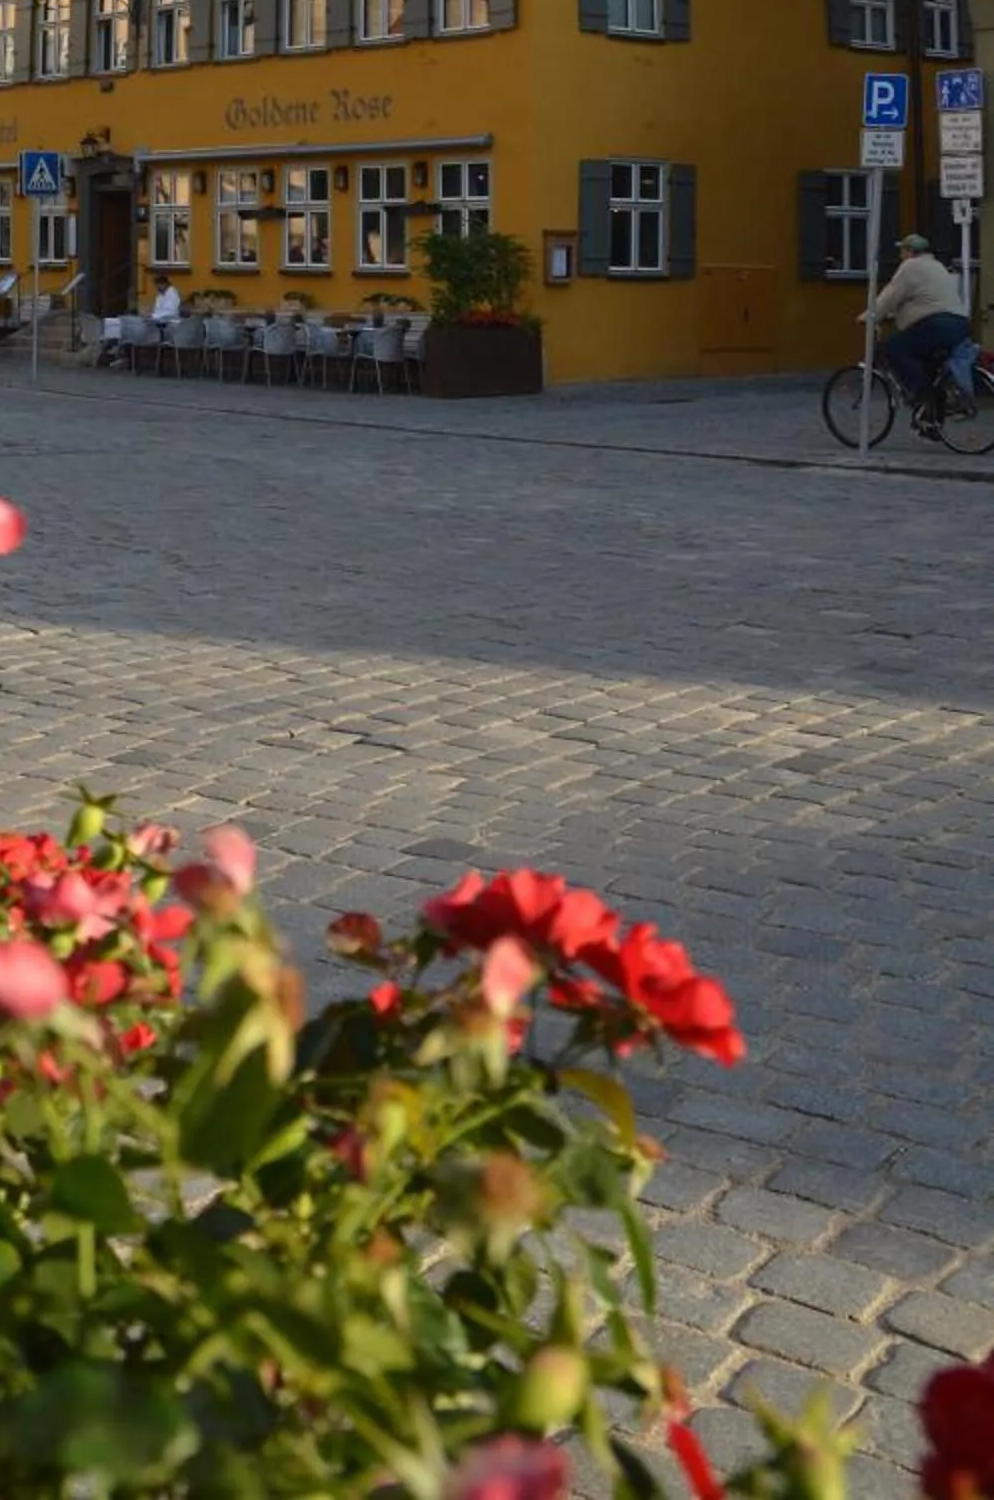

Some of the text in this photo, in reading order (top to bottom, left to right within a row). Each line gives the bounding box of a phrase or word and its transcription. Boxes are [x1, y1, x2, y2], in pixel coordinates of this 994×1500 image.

[225, 88, 393, 131] Goldene Rose
[870, 81, 895, 118] P
